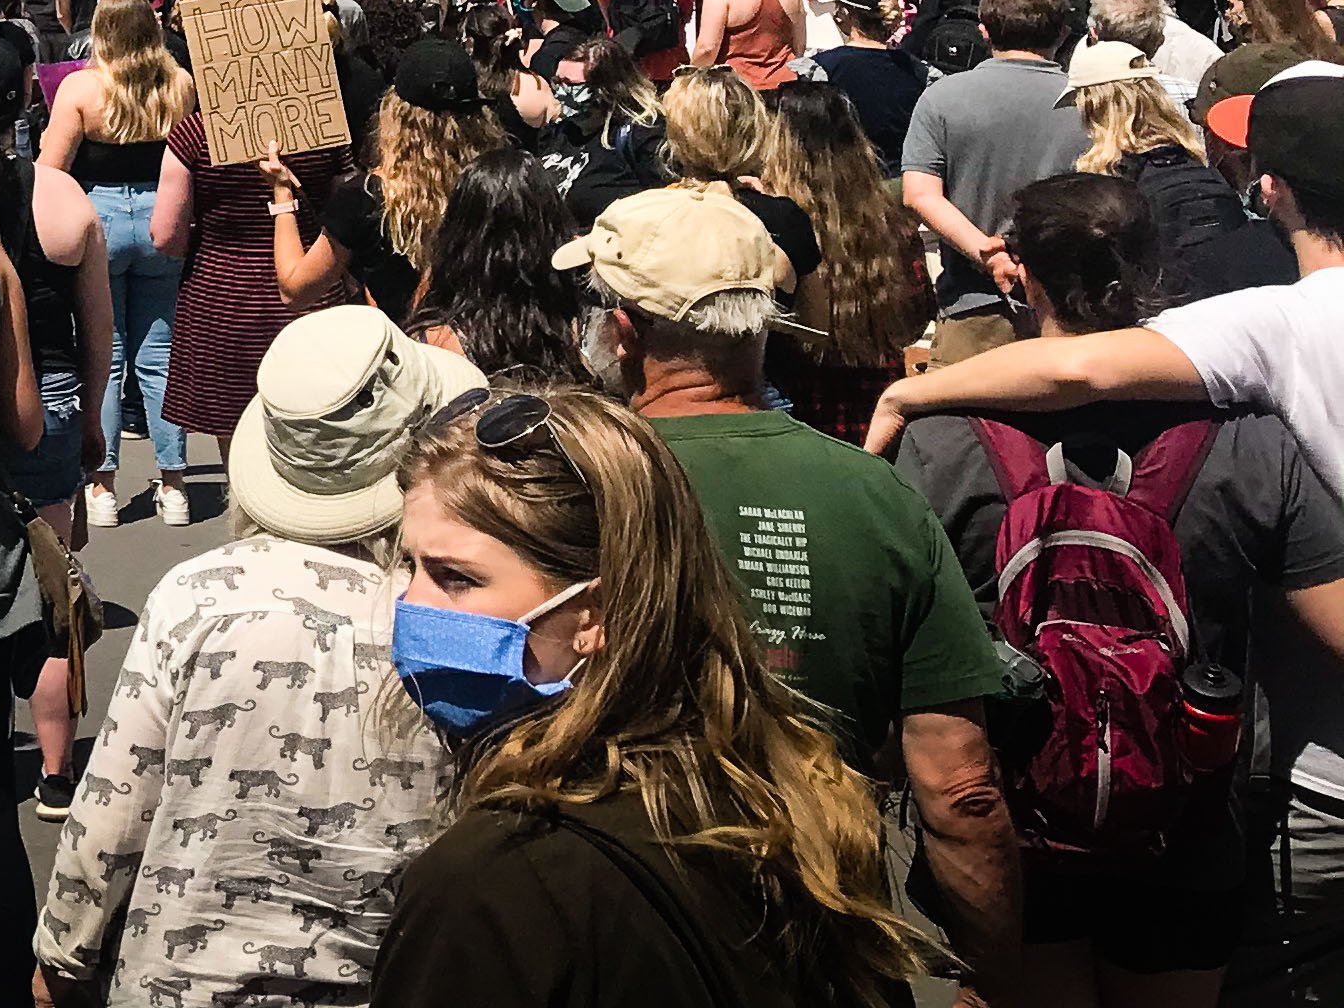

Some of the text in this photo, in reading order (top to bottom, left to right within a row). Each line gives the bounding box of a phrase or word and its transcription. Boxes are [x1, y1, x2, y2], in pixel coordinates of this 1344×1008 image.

[203, 43, 332, 110] MANY
[209, 90, 347, 163] MORE
[766, 562, 810, 575] WILLIAMSON
